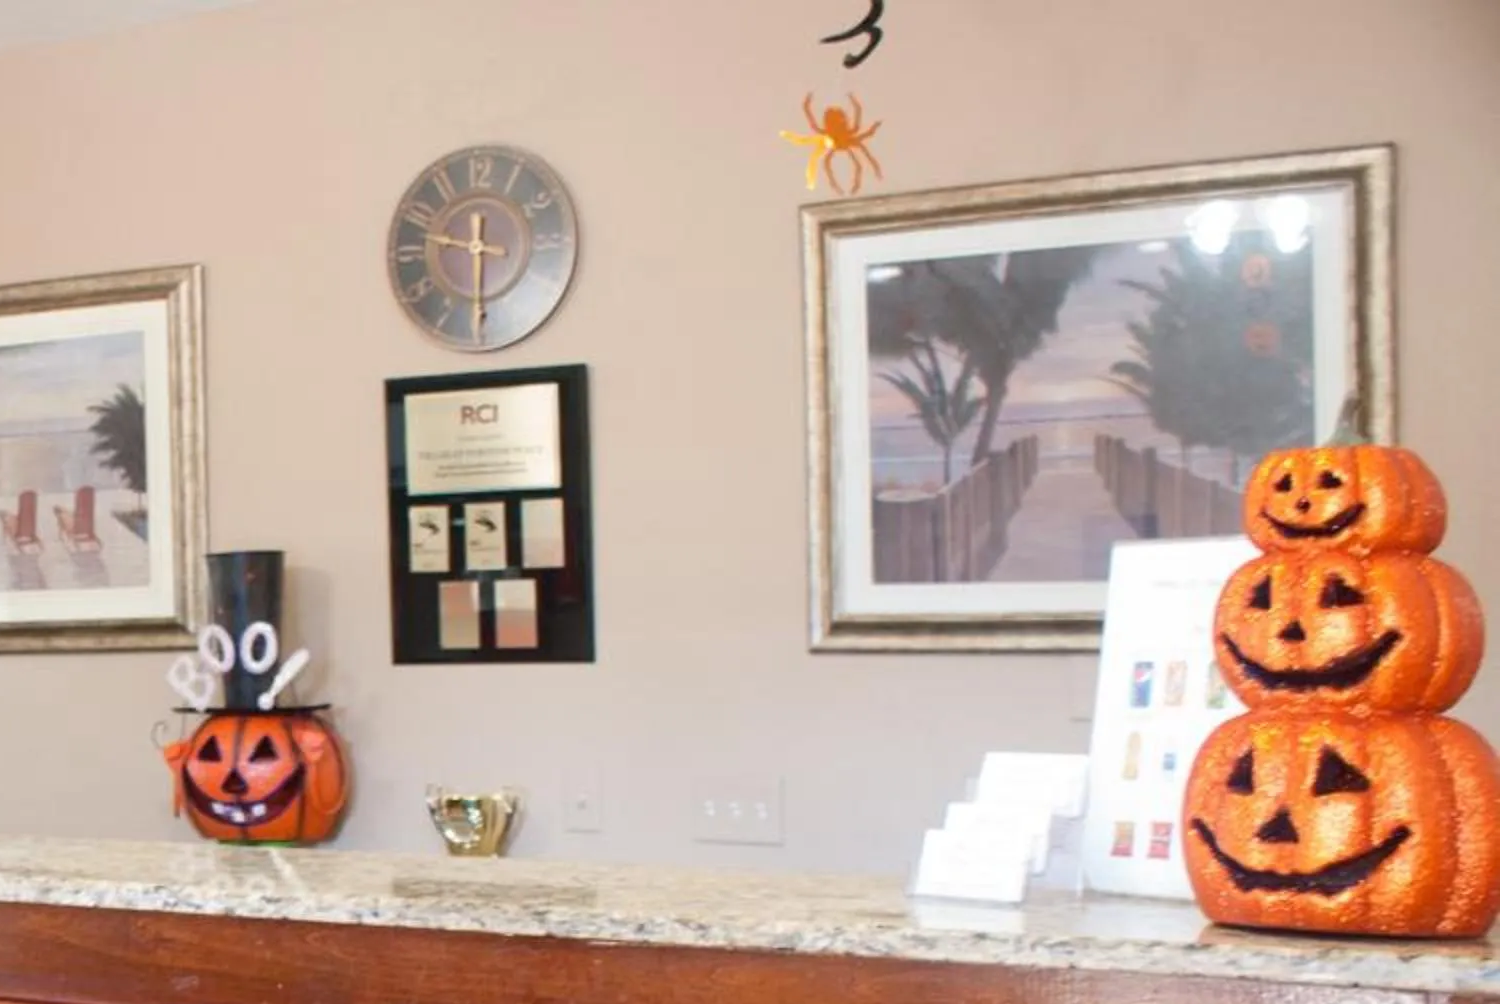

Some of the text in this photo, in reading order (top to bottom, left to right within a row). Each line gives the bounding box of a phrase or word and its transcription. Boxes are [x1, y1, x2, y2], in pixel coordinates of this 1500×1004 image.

[431, 166, 457, 201] 11
[467, 156, 494, 189] 12
[460, 404, 499, 425] RCI
[166, 620, 312, 712] BOO!
